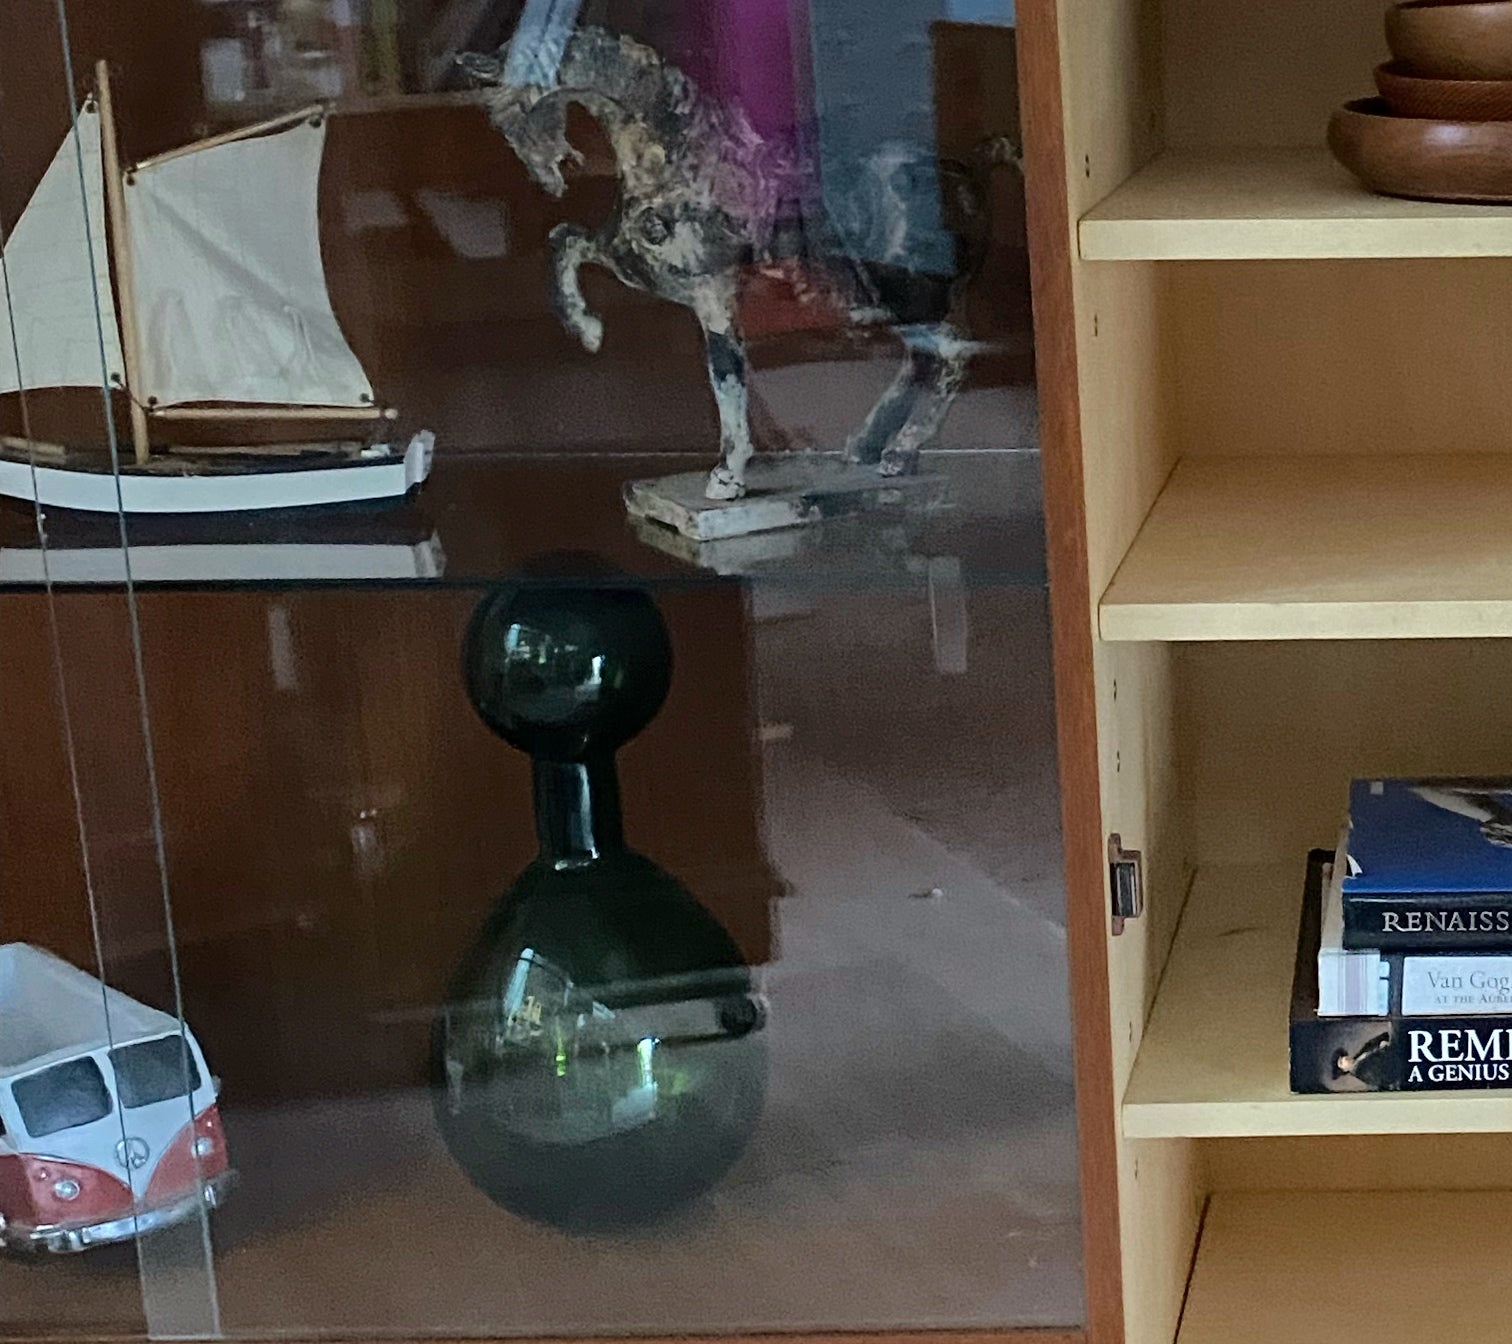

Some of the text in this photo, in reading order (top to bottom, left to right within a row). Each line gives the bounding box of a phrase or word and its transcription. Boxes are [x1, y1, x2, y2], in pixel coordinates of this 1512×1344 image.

[1428, 970, 1463, 989] Van
[1408, 1065, 1423, 1082] A
[1428, 1063, 1509, 1082] GENIUS
